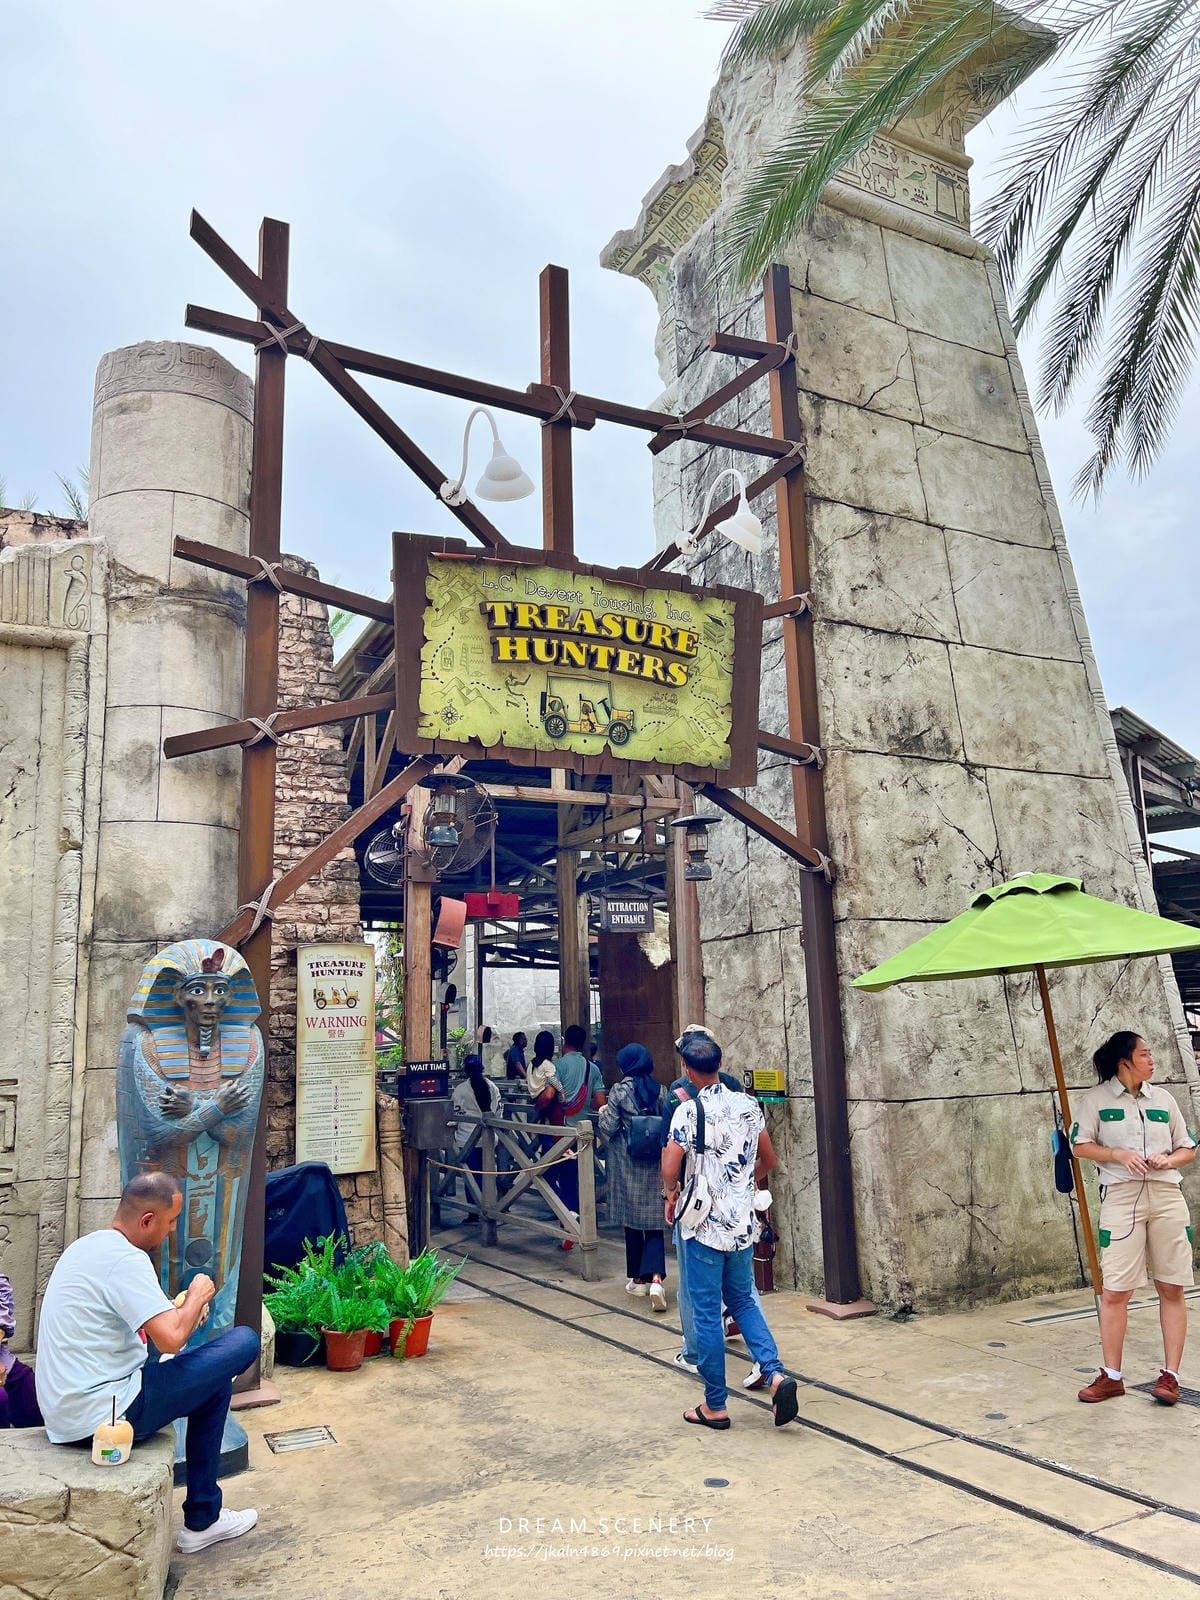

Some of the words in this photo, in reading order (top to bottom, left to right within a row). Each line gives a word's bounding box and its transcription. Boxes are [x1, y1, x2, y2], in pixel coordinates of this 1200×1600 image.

[481, 571, 514, 592] L.C.
[524, 578, 584, 604] Desert
[666, 602, 693, 622] Inc.
[482, 600, 700, 658] TREASURE
[493, 635, 689, 688] HUNTERS
[607, 902, 649, 912] ATTRACTION
[611, 914, 646, 924] ENTRANCE
[307, 960, 367, 970] TREASURE
[311, 969, 364, 978] HUNTERS
[305, 1015, 368, 1029] WARNING
[327, 1028, 346, 1039] 警告
[409, 1063, 428, 1072] WAIT
[429, 1062, 447, 1071] TIME
